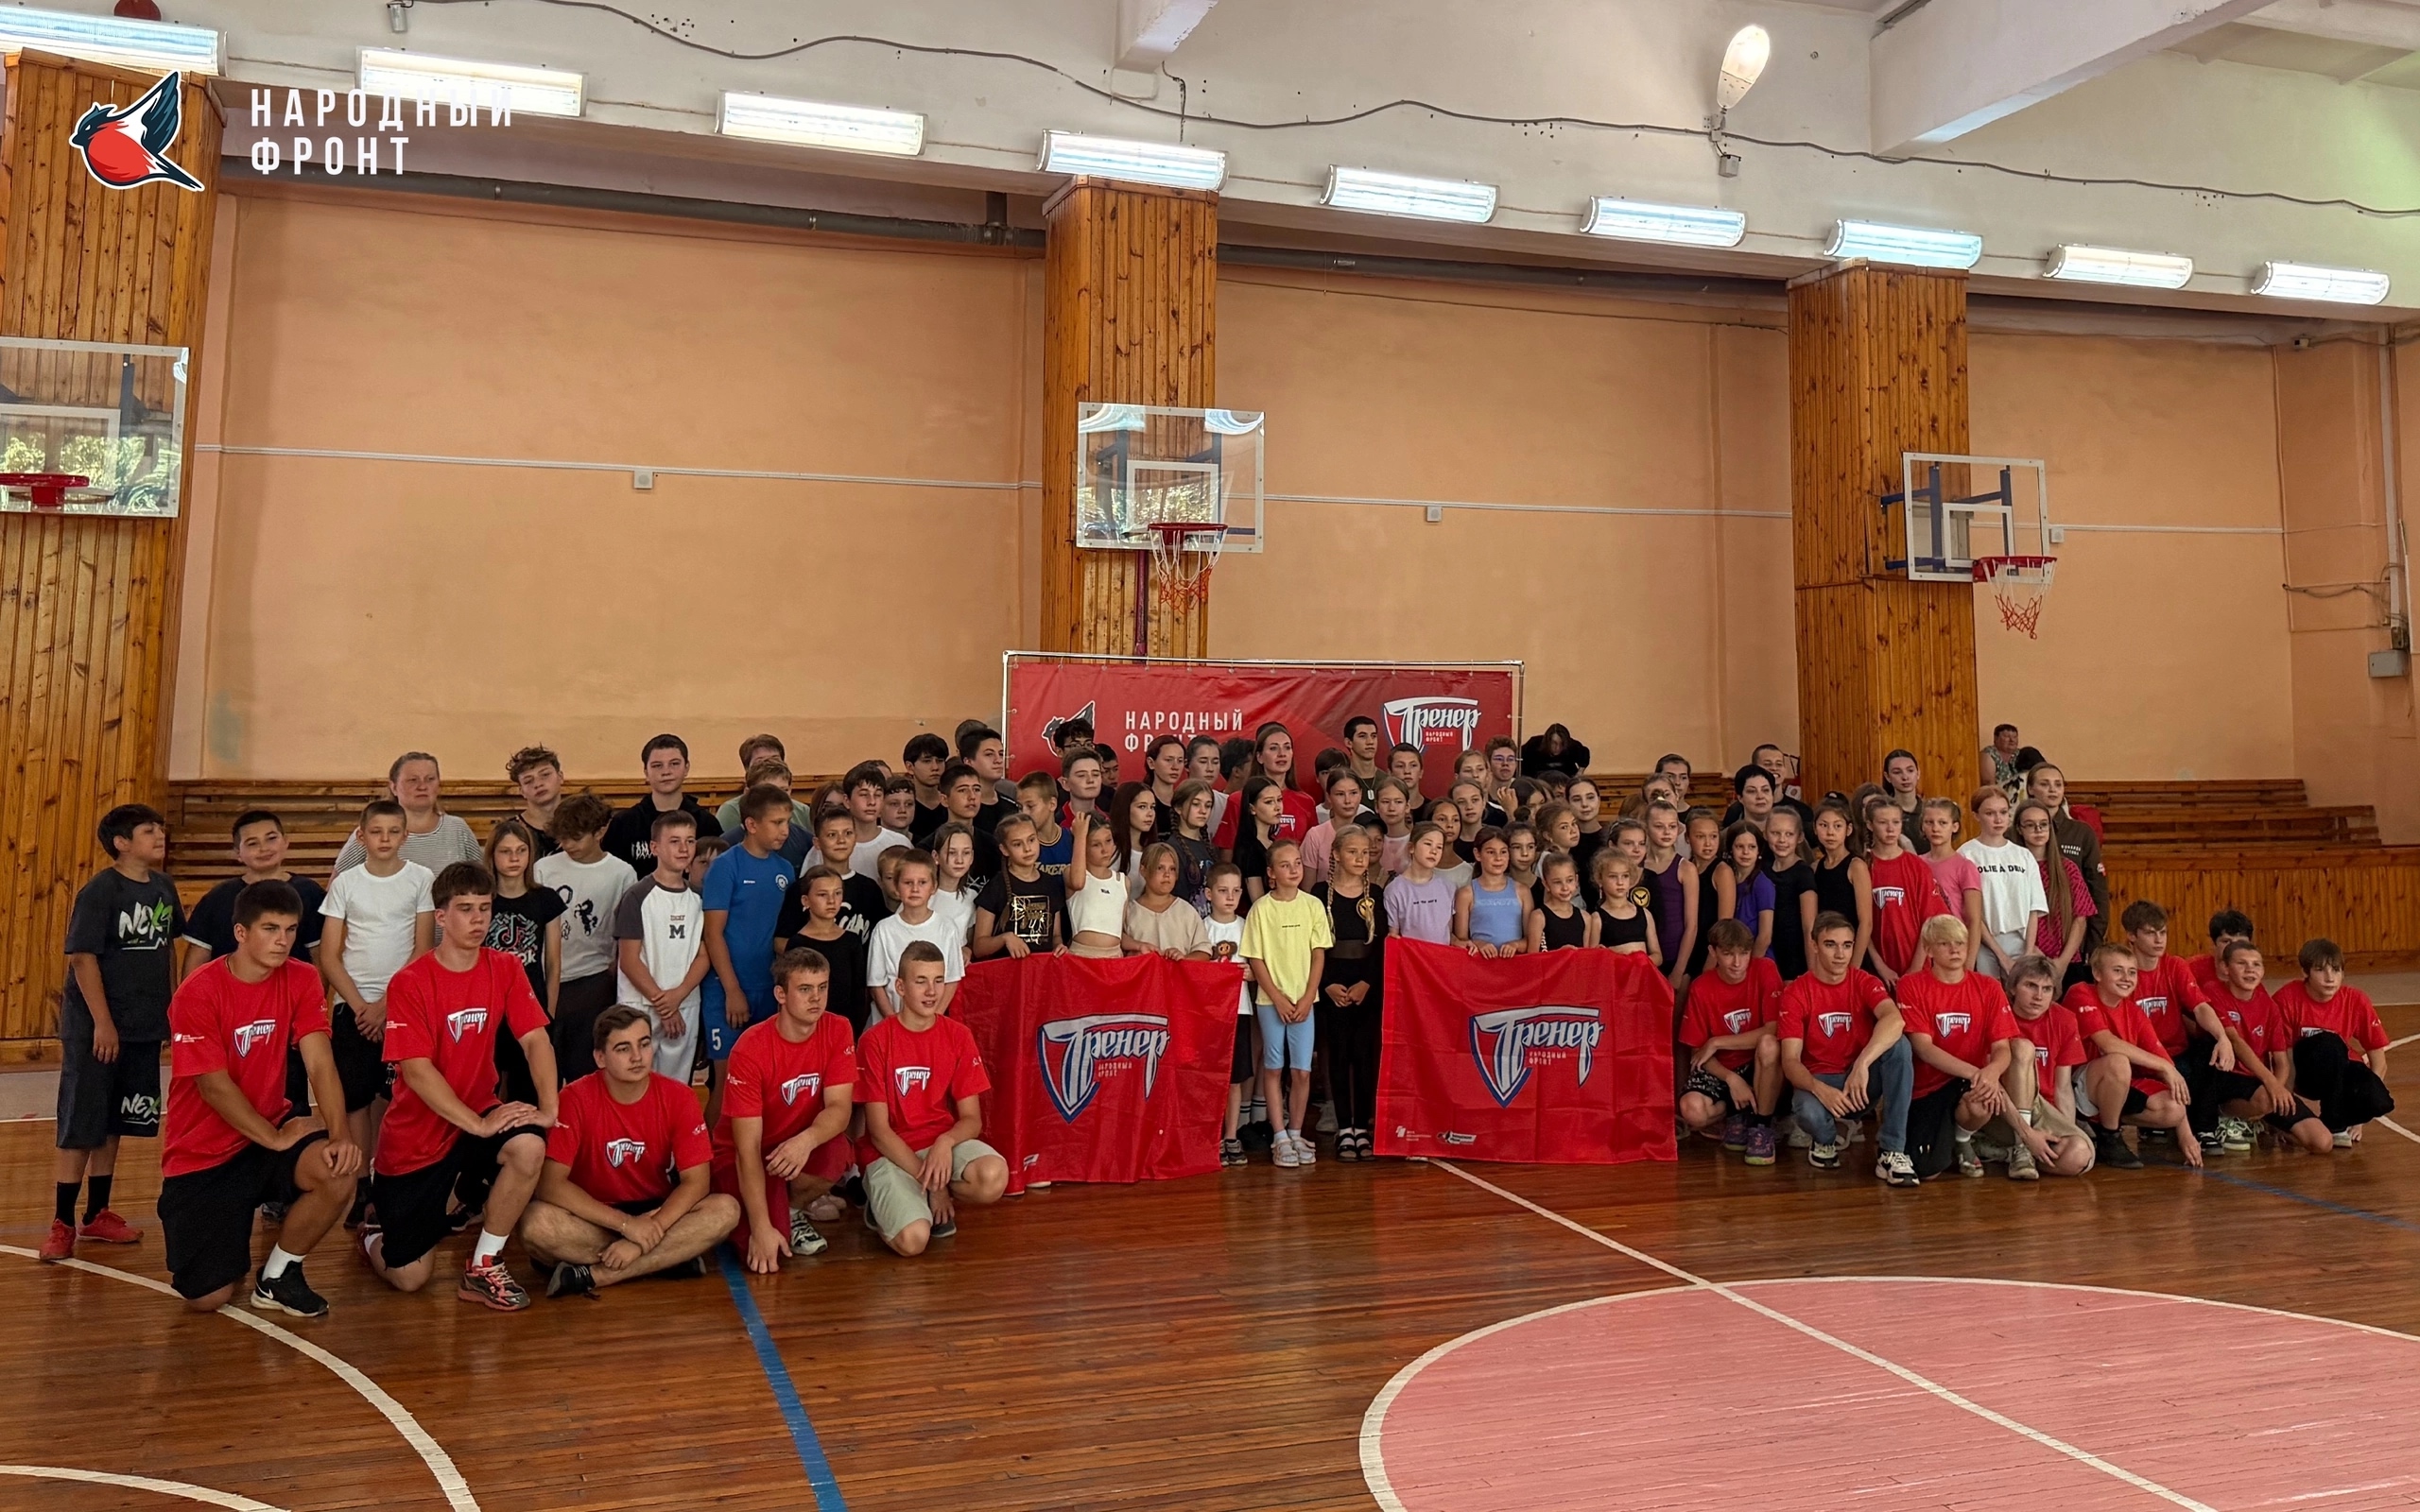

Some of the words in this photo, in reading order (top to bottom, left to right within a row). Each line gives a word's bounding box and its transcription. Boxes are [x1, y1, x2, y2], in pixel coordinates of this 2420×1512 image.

[1125, 708, 1243, 733] НАРОДНЫЙ
[1384, 696, 1481, 752] Тренер
[669, 924, 685, 939] M
[712, 1028, 722, 1051] 5
[1474, 1005, 1604, 1093] Тренер
[1043, 1013, 1170, 1108] Тренер
